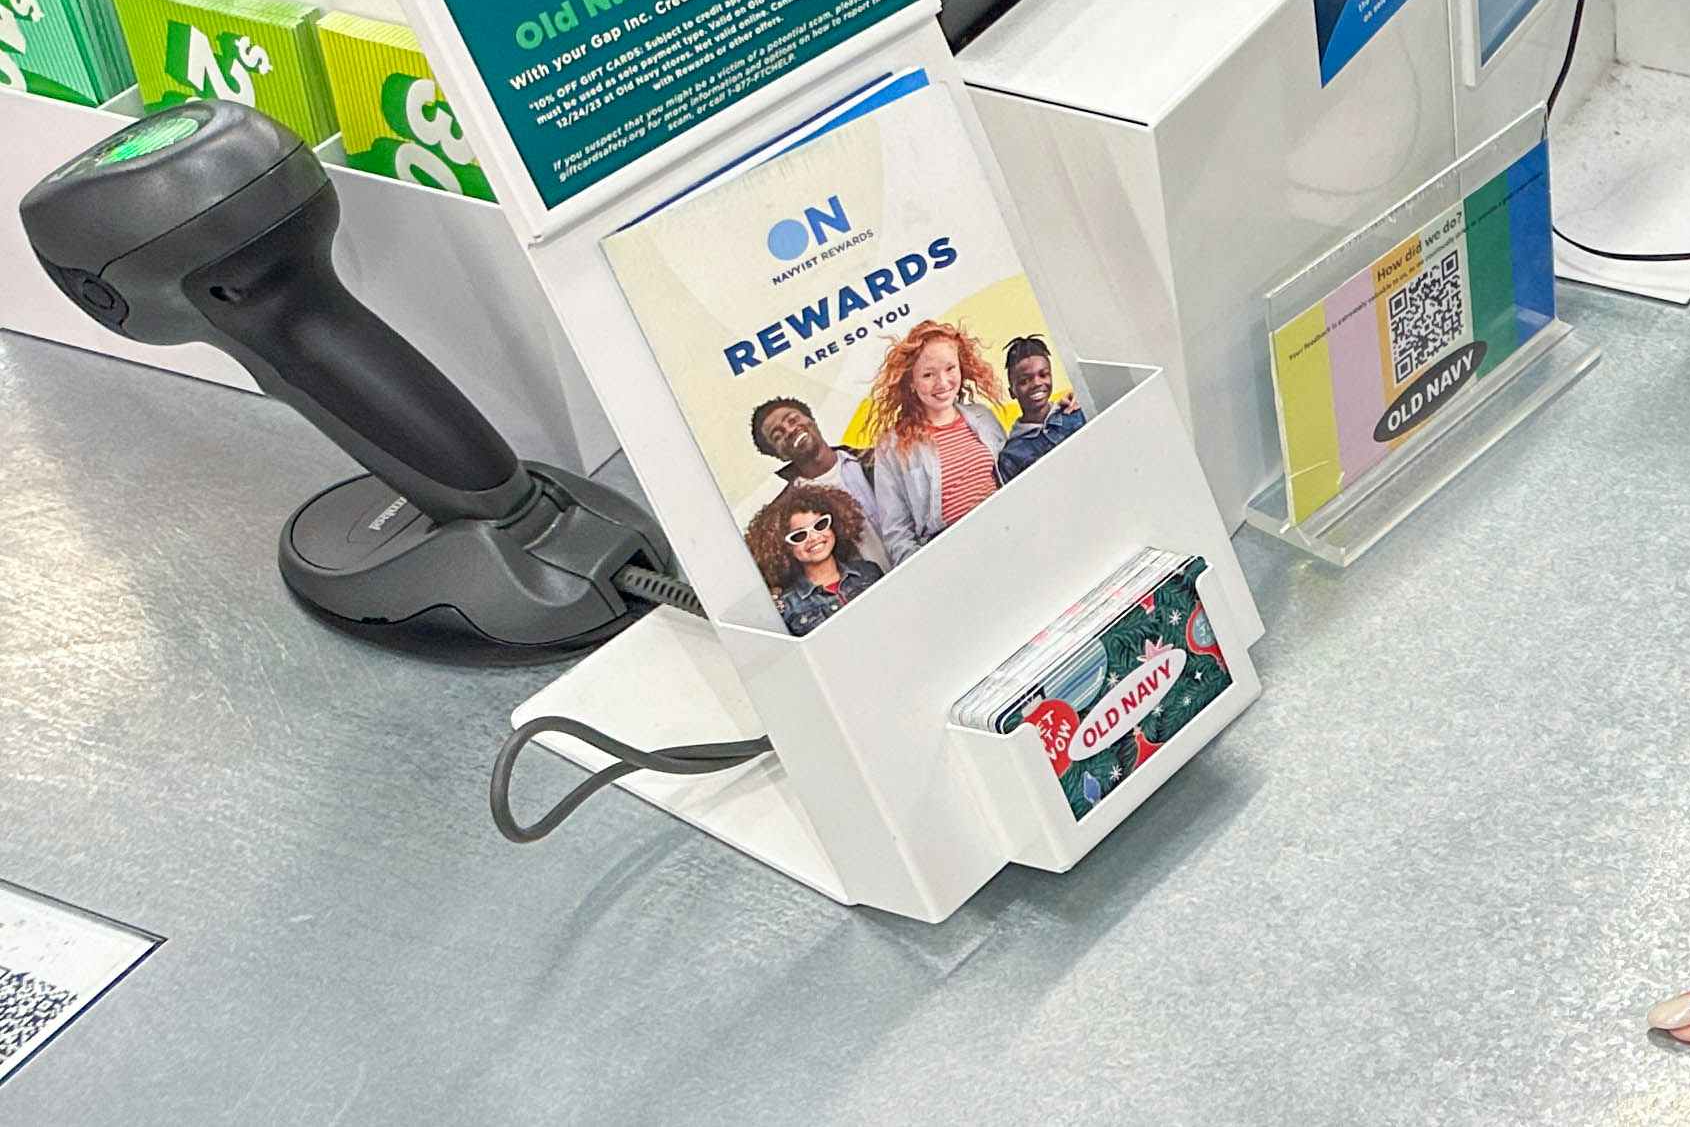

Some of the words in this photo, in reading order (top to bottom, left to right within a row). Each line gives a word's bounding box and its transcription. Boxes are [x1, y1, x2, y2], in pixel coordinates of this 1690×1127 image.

[510, 64, 548, 89] With
[552, 44, 585, 70] your
[591, 27, 620, 47] Gap
[624, 13, 651, 30] Inc.
[515, 0, 578, 49] Old
[556, 80, 576, 97] OFF
[580, 66, 602, 84] GIFT
[606, 47, 642, 70] CARDS:
[645, 26, 681, 50] Subject
[682, 21, 693, 29] to
[695, 4, 722, 22] credit
[652, 75, 673, 89] with
[675, 53, 714, 77] Rewards
[716, 45, 725, 54] or
[729, 31, 751, 48] other
[755, 16, 783, 33] offers.
[537, 105, 561, 123] must
[563, 98, 576, 109] be
[579, 82, 602, 101] used
[605, 77, 615, 87] as
[618, 65, 637, 79] sole
[640, 41, 681, 69] payment
[682, 29, 706, 44] type.
[708, 12, 732, 29] Valid
[734, 7, 745, 16] on
[556, 98, 601, 127] 12/24/23
[604, 92, 613, 102] at
[616, 81, 633, 95] Old
[635, 68, 658, 84] Navy
[661, 51, 692, 70] stores.
[694, 38, 712, 52] Not
[714, 24, 736, 41] valid
[738, 10, 767, 28] online.
[772, 256, 817, 284] NAVYIST
[820, 229, 873, 260] REWARDS
[1377, 254, 1401, 282] How
[1405, 239, 1422, 262] did
[1424, 228, 1440, 248] we
[1442, 209, 1462, 235] do?
[723, 237, 956, 375] REWARDS
[804, 341, 838, 368] ARE
[844, 327, 867, 345] SO
[873, 303, 909, 328] YOU
[1387, 390, 1423, 431] OLD
[1426, 348, 1476, 402] NAVY
[1082, 713, 1120, 748] OLD
[1120, 659, 1172, 715] NAVY
